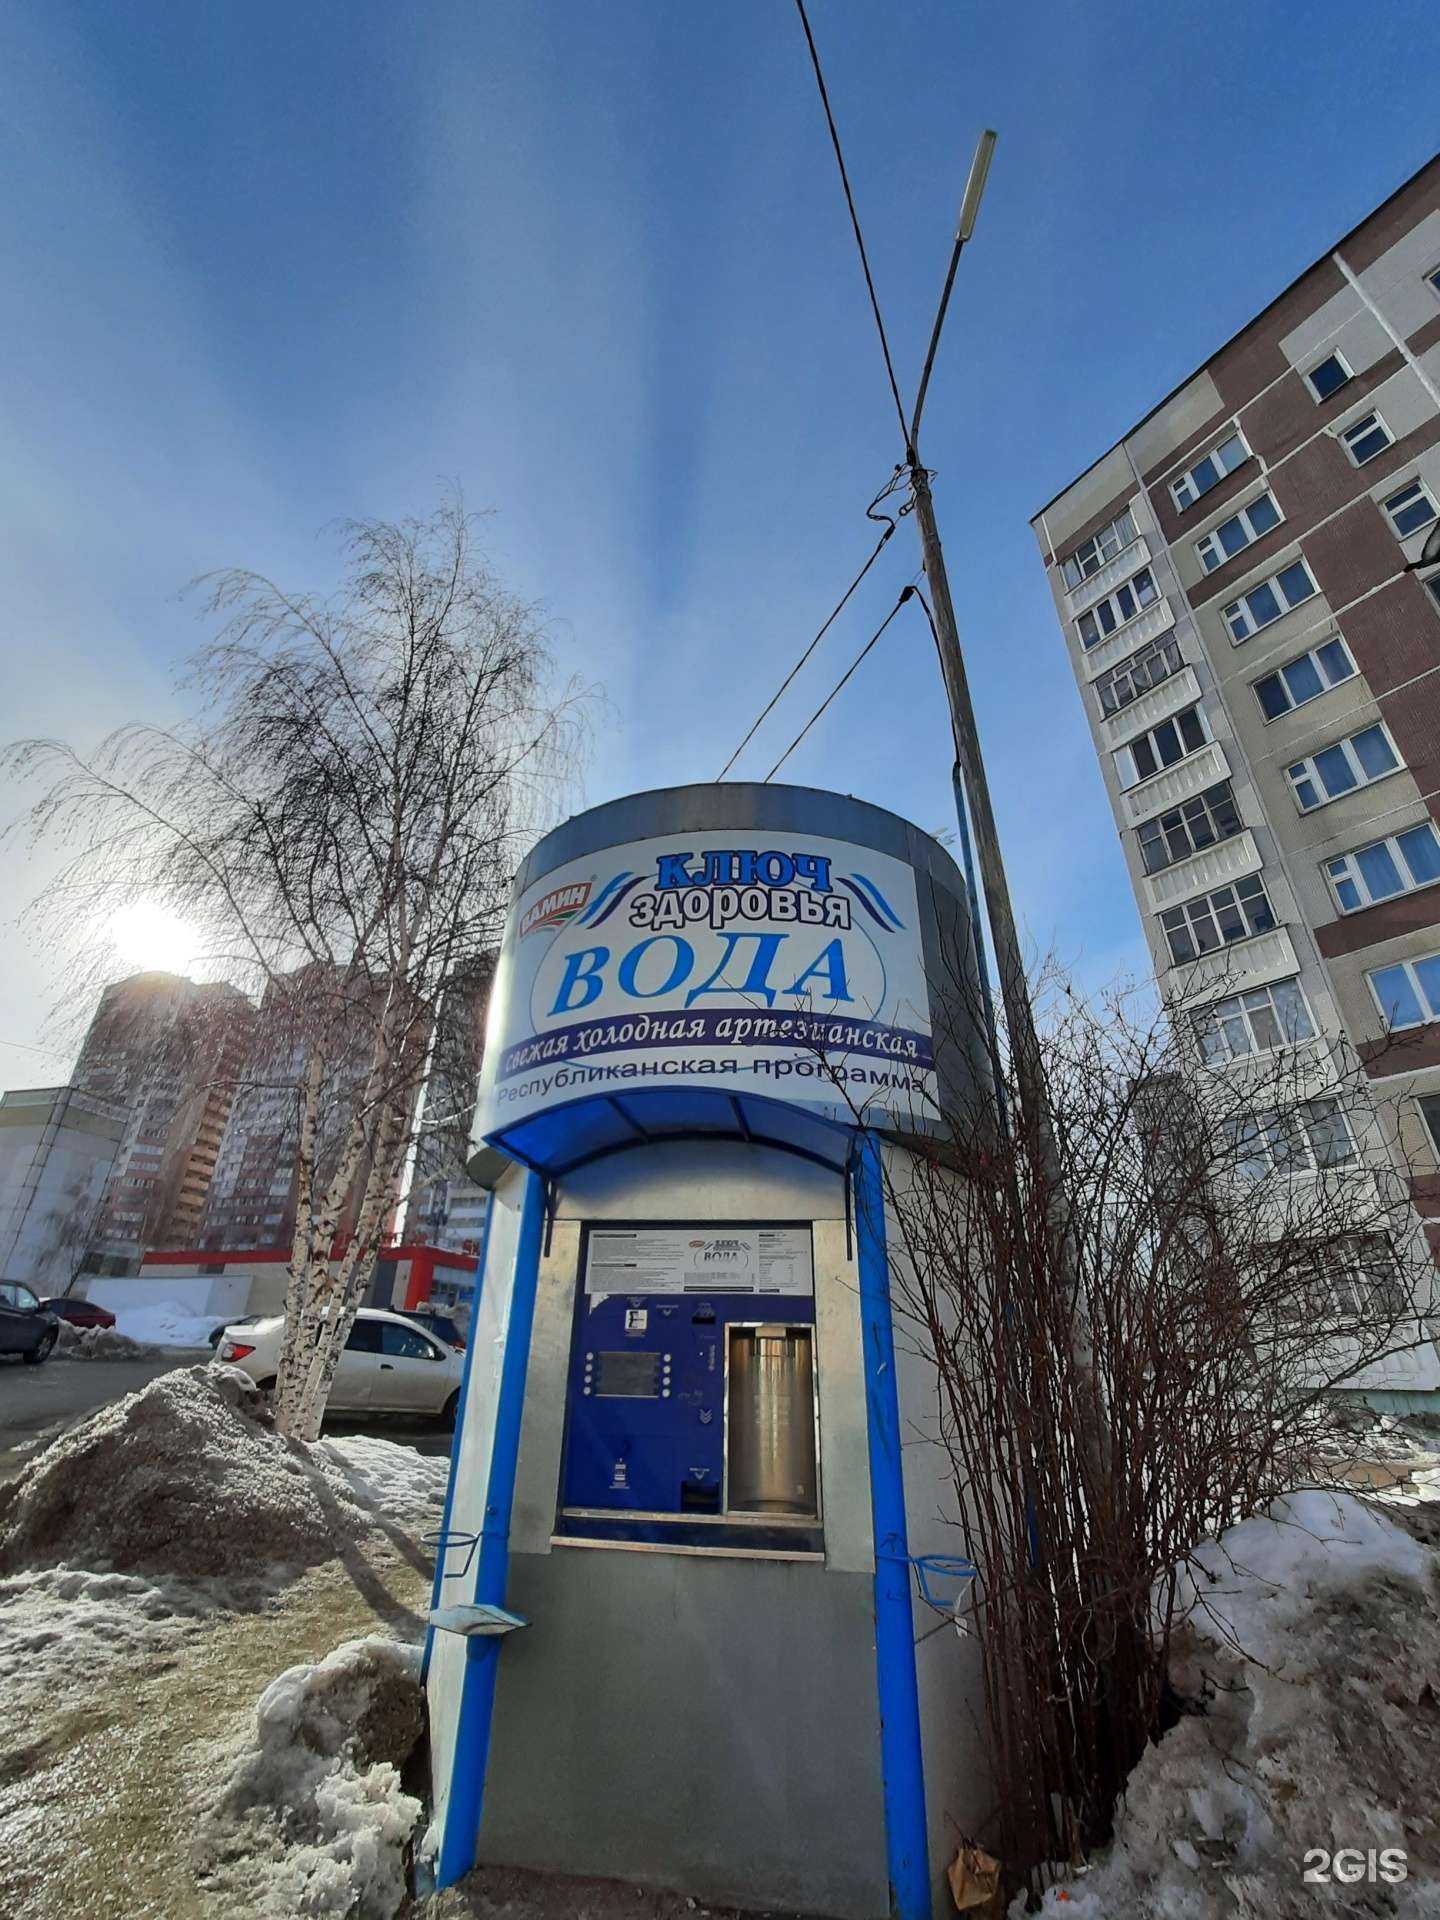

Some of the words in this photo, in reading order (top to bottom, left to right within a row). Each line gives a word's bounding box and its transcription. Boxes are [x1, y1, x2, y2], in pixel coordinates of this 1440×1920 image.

[655, 850, 834, 893] КЛЮЧ
[547, 932, 855, 1017] ВОДА
[506, 1034, 569, 1073] свежая
[573, 1014, 706, 1053] холодная
[715, 1014, 919, 1059] артезианская
[498, 1059, 738, 1104] Республиканская
[752, 1058, 924, 1094] программа
